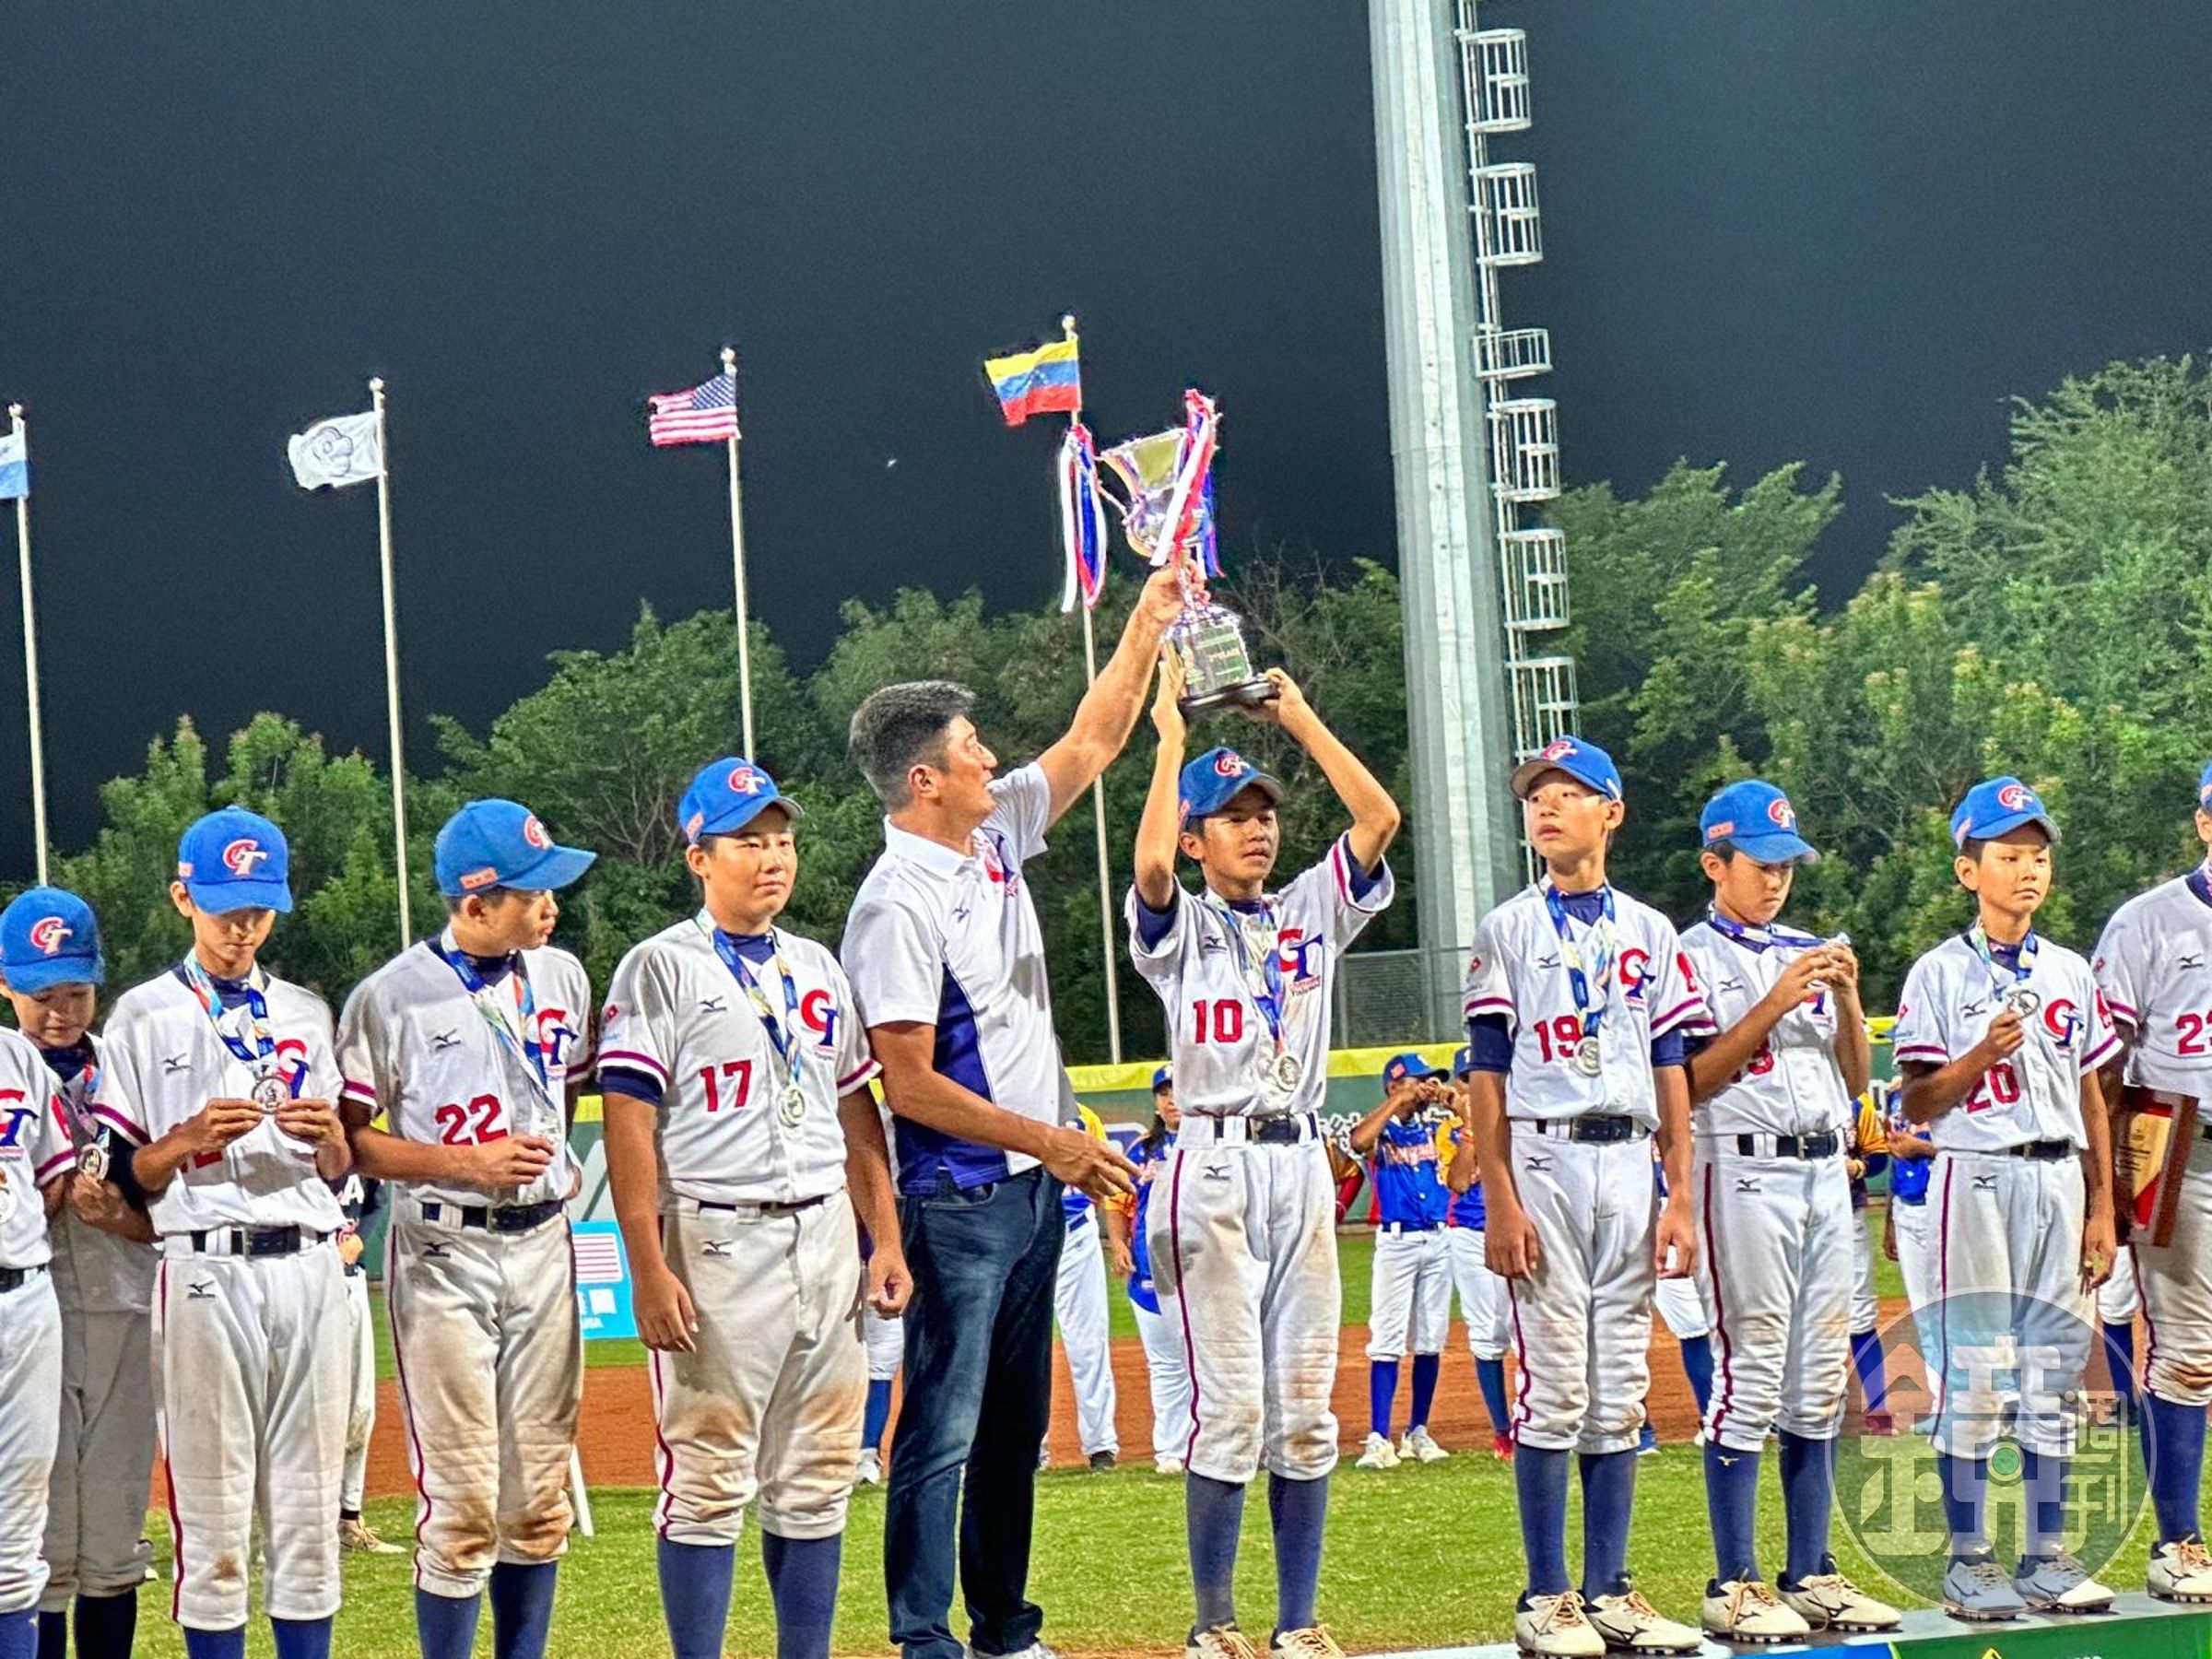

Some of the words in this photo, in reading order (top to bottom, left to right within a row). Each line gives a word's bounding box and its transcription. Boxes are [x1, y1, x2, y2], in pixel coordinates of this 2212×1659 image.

[1193, 998, 1242, 1044] 10
[1534, 1015, 1583, 1063] 19
[2175, 1012, 2212, 1054] 2
[700, 1060, 752, 1112] 17
[1967, 1063, 2020, 1113] 20
[433, 1093, 508, 1147] 22
